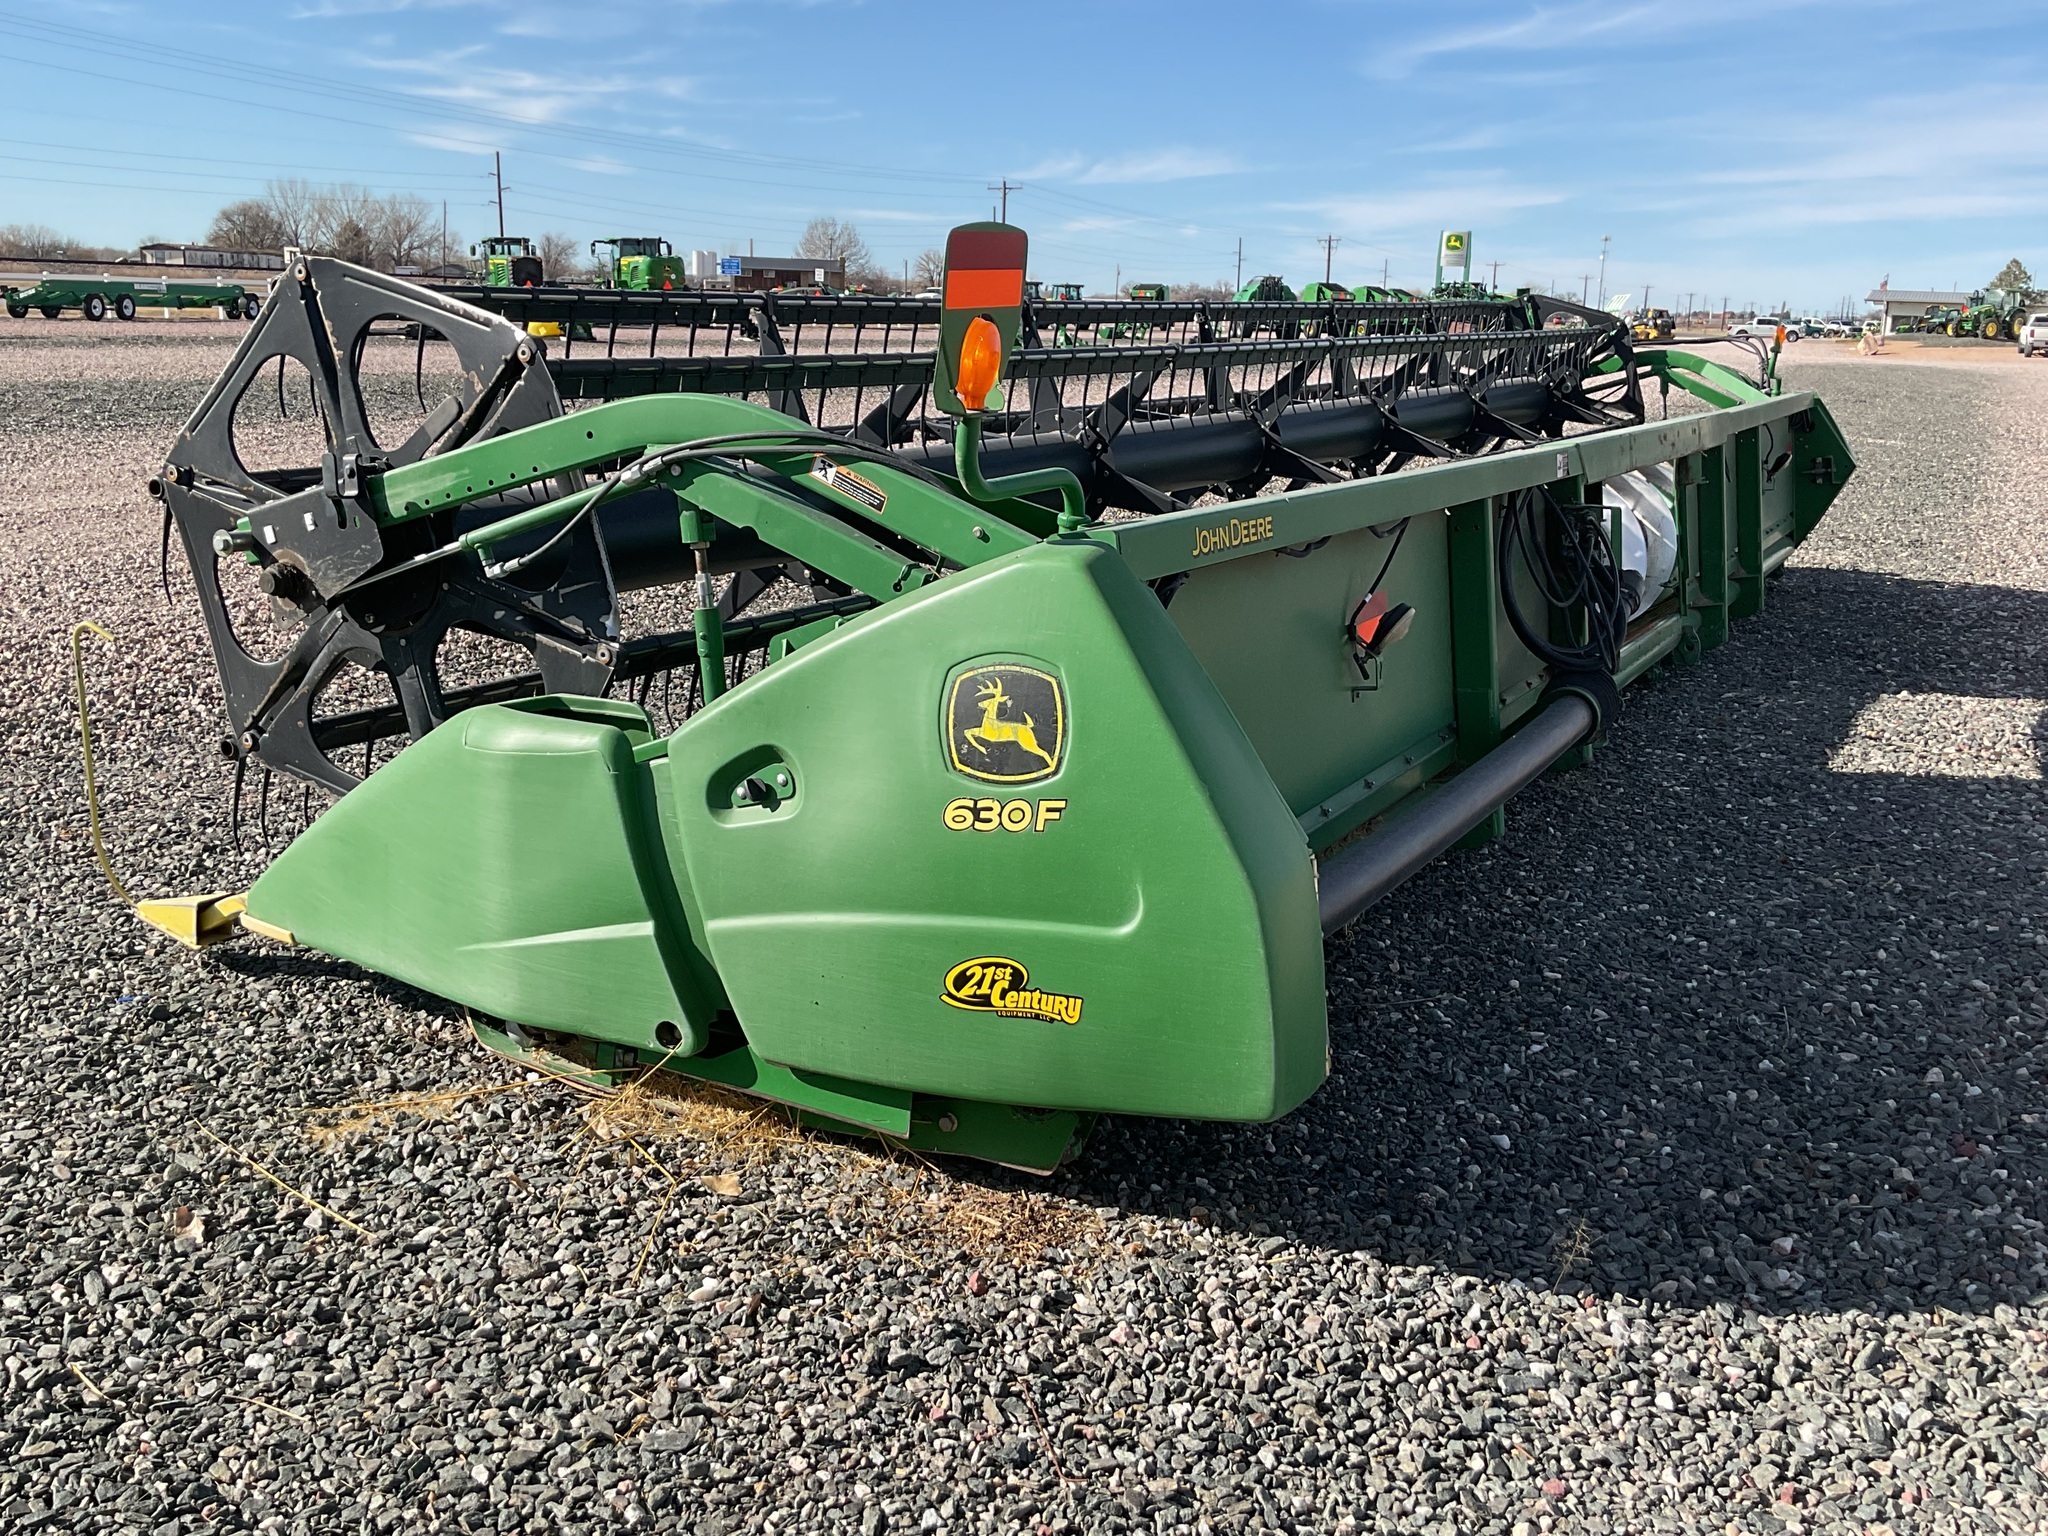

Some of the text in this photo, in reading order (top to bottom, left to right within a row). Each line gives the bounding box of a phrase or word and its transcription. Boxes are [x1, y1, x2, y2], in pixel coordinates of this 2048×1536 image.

[1192, 516, 1274, 556] JOHN DEERE
[943, 798, 1067, 832] 630F
[958, 965, 1013, 996] 21st
[997, 1010, 1036, 1018] EQUIPMENT
